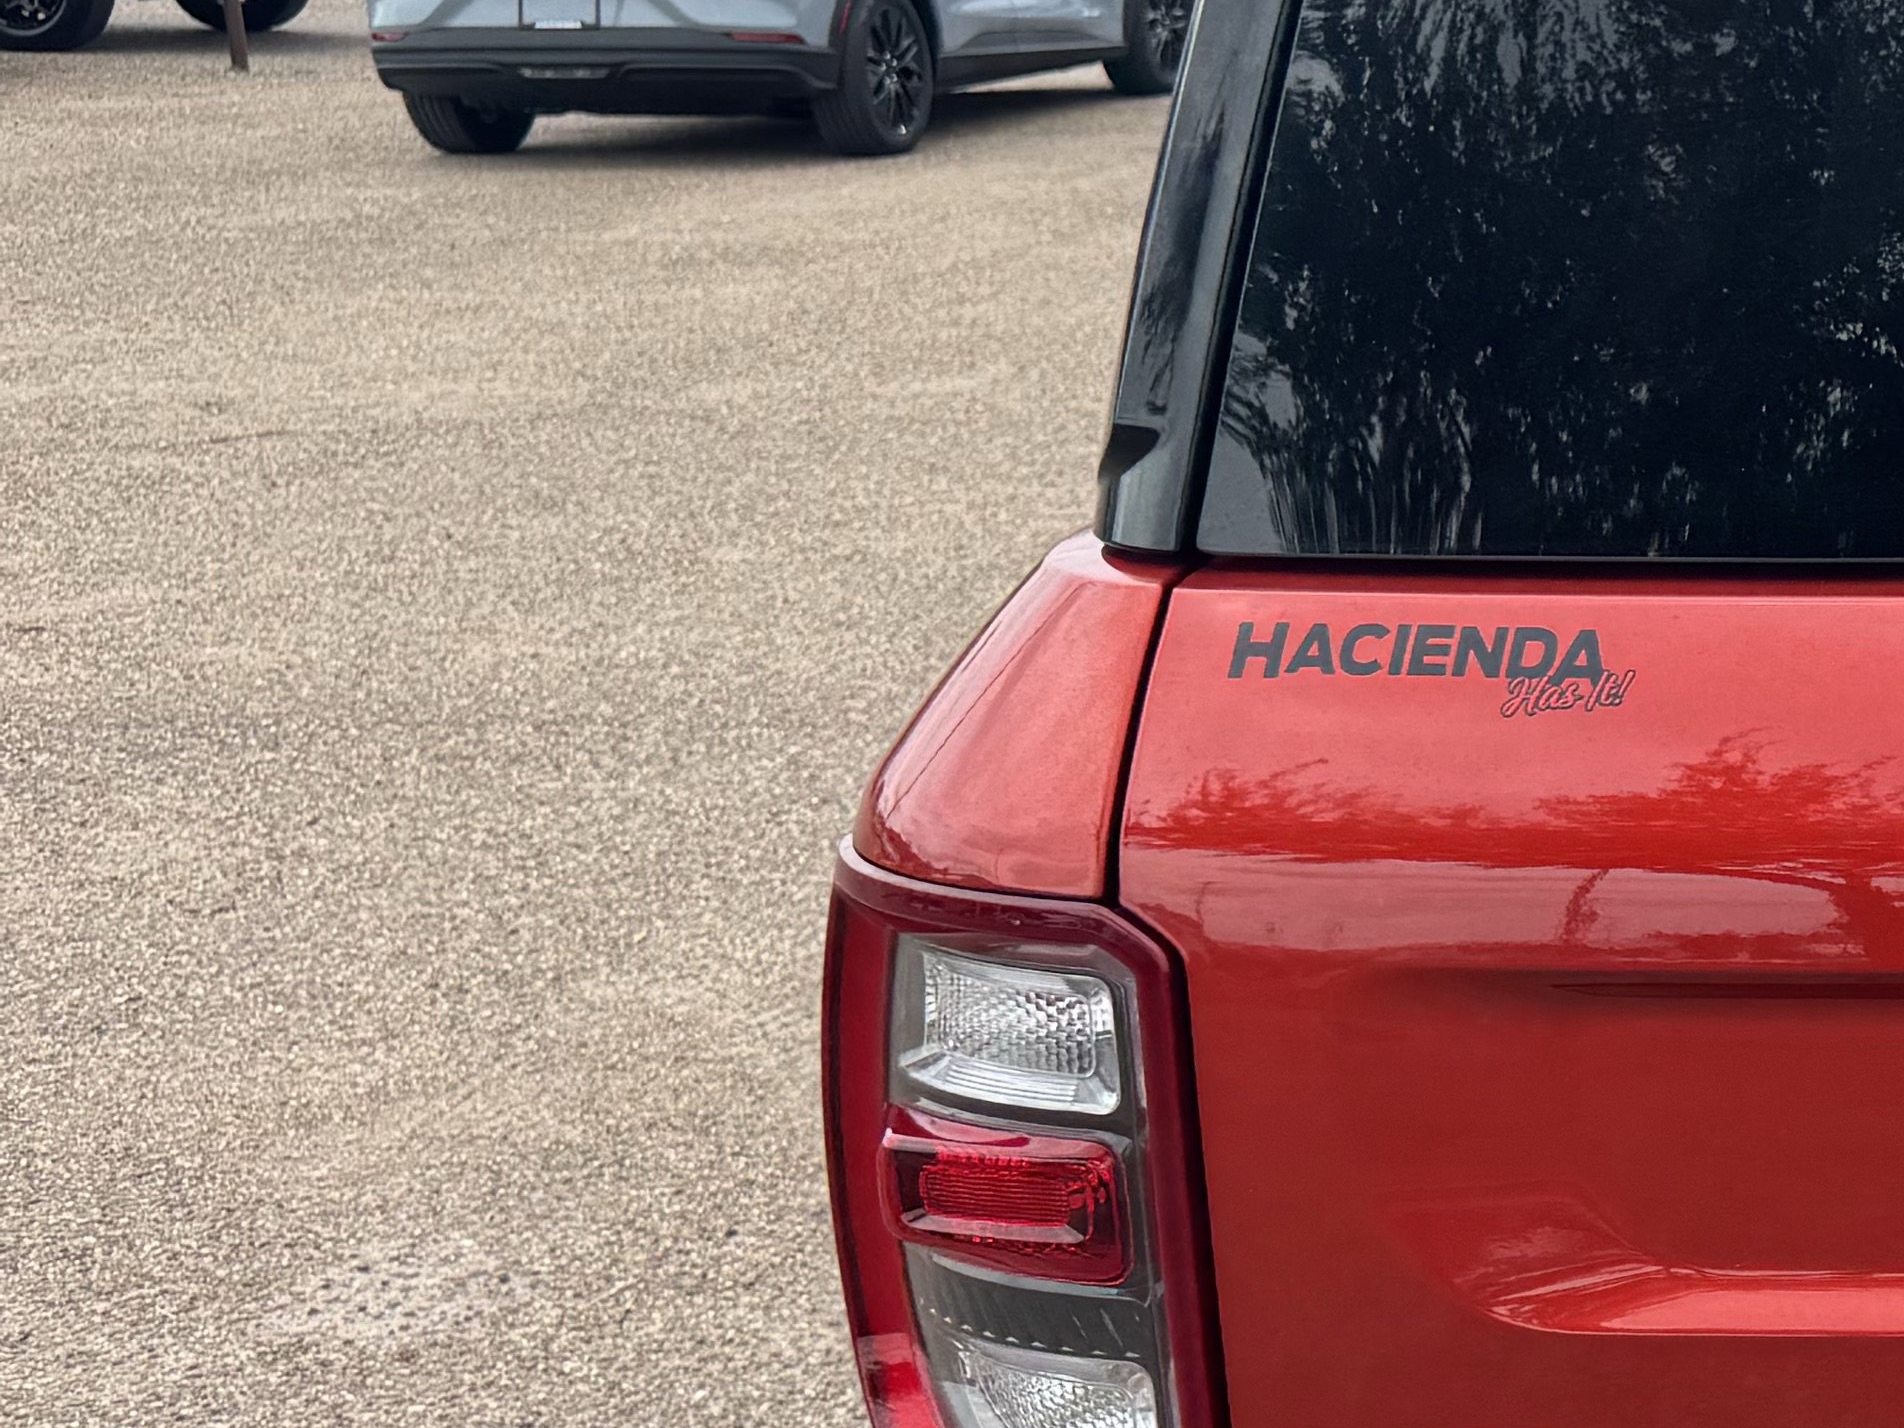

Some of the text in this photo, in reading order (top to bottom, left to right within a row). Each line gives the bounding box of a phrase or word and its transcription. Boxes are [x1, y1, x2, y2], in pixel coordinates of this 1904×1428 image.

[1227, 621, 1605, 690] HACIENDA
[1501, 669, 1637, 717] Has It!
